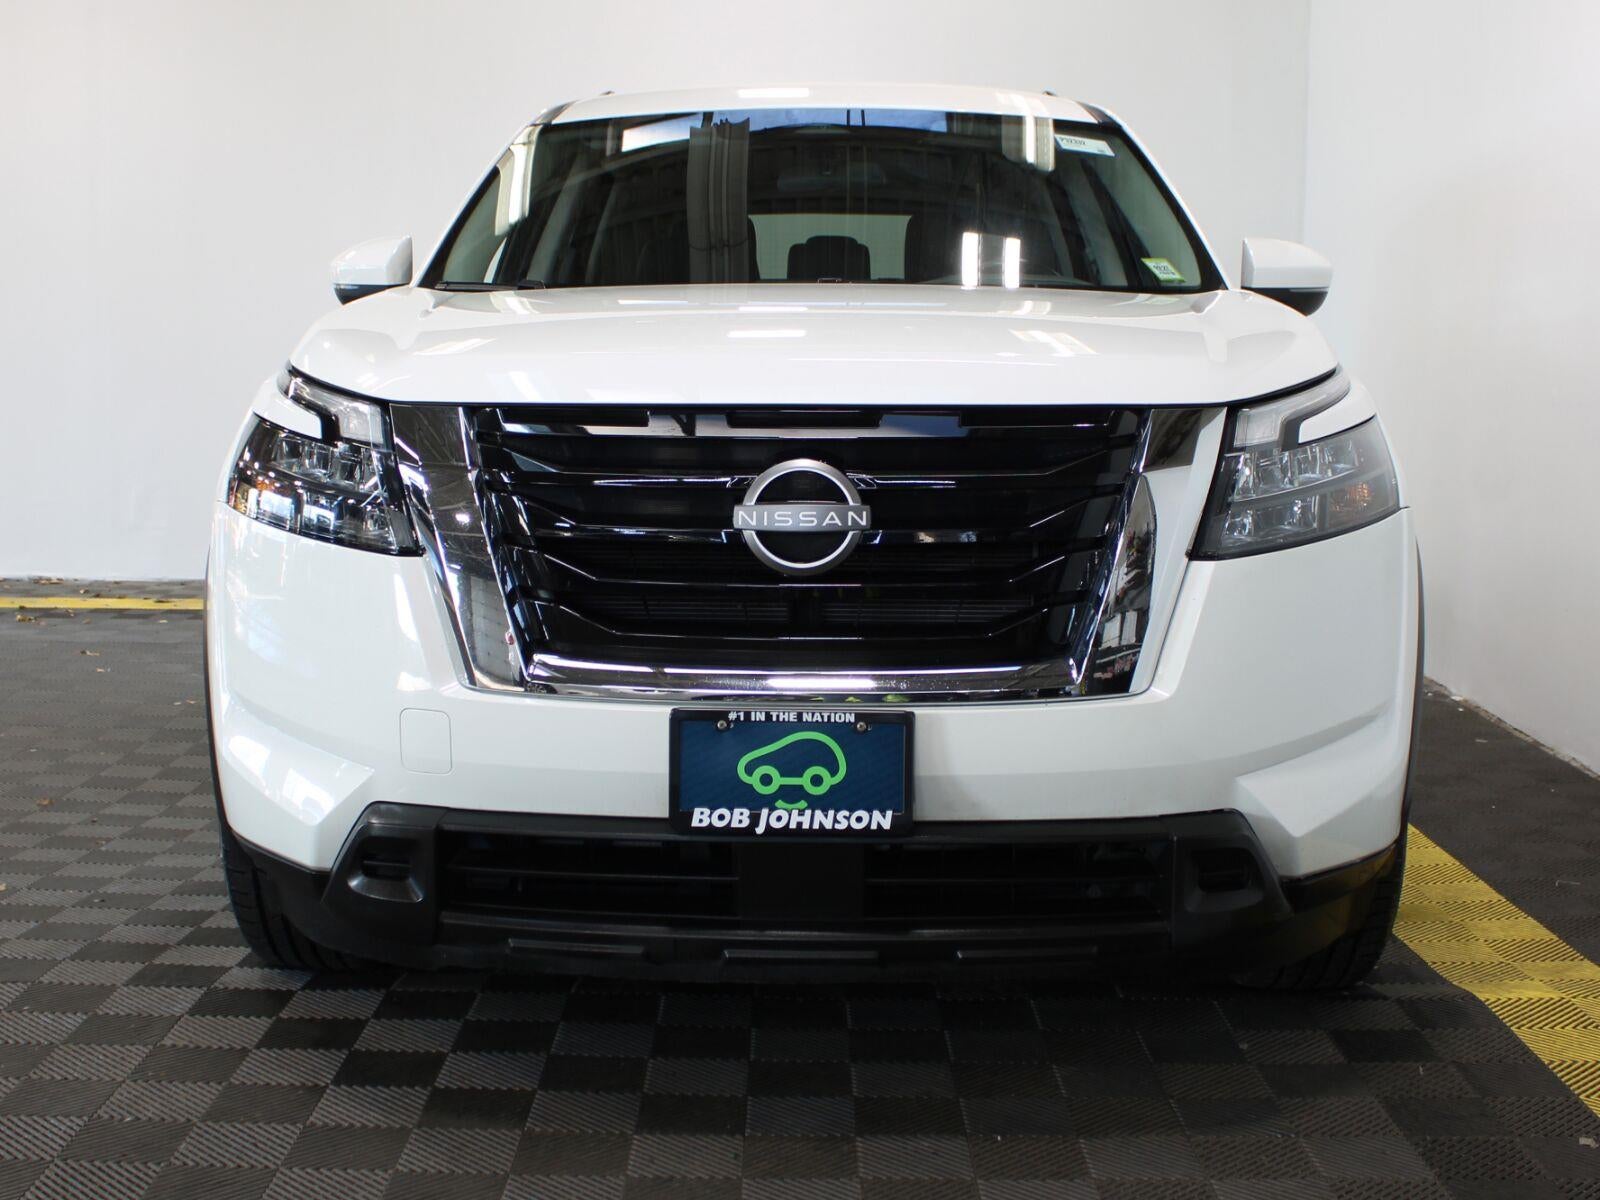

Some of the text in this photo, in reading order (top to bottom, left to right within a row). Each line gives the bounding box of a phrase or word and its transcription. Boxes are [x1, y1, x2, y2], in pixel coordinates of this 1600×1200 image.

[738, 511, 867, 526] NISSAN
[728, 711, 855, 723] #1 IN THE NATION
[691, 807, 893, 835] BOB JOHNSON
